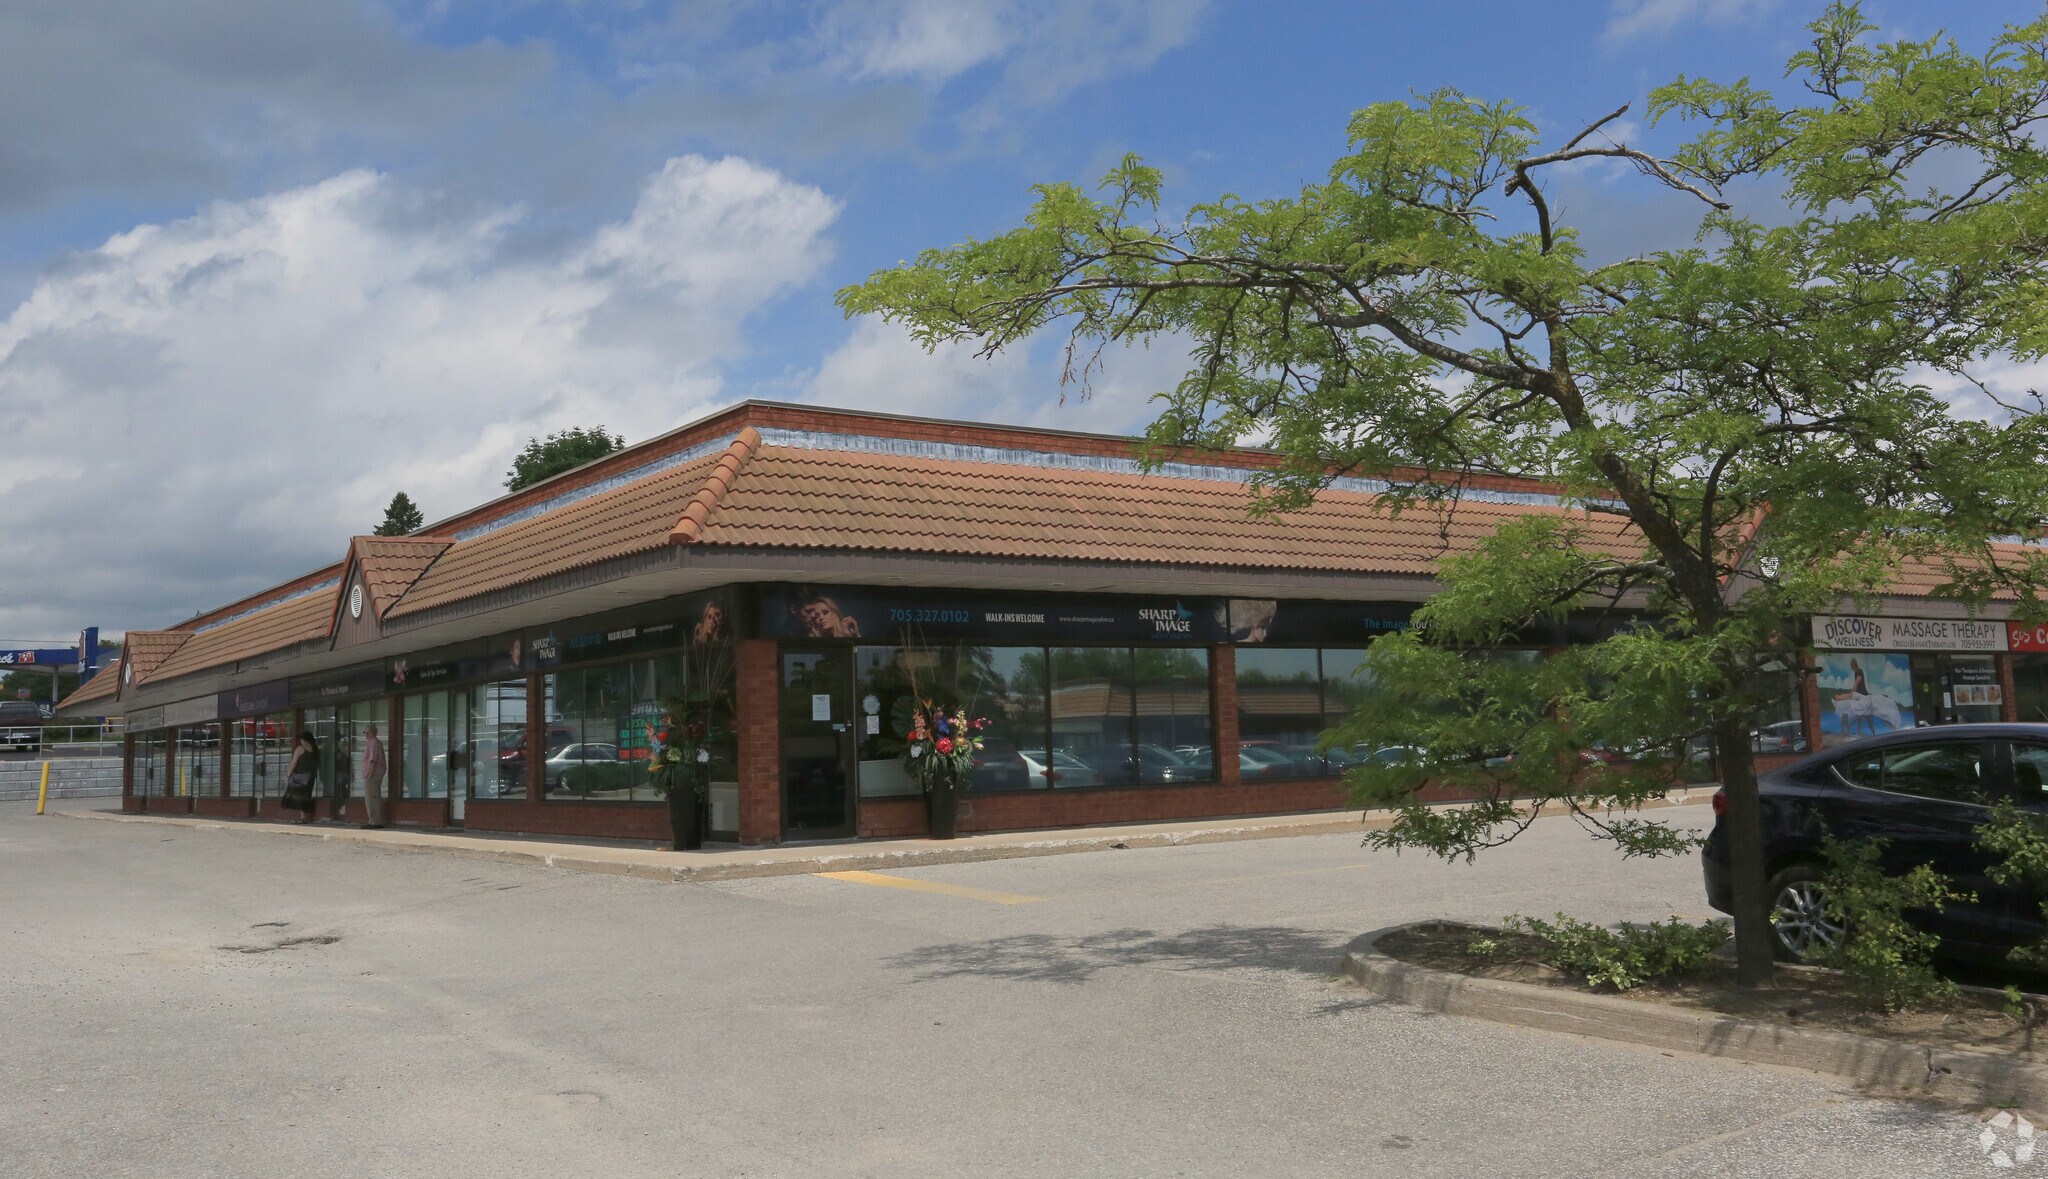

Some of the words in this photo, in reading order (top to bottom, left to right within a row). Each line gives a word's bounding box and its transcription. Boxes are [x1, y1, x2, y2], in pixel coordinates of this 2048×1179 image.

[889, 608, 970, 623] 705.327.0102
[985, 612, 1015, 623] WALK-INS
[1015, 613, 1045, 624] WELCOME
[1058, 615, 1115, 625] www.sharpimagesalon.ca
[1138, 608, 1177, 621] SHARP
[1155, 620, 1191, 632] IMAGE
[1364, 618, 1380, 629] The
[1382, 619, 1409, 631] Image
[1825, 618, 1882, 642] DISCOVER
[1892, 621, 1948, 638] MASSAGE
[1951, 623, 1996, 639] THERAPY
[532, 637, 550, 650] SHARP
[1834, 636, 1875, 648] WELLNESS
[539, 647, 556, 660] IMAGE
